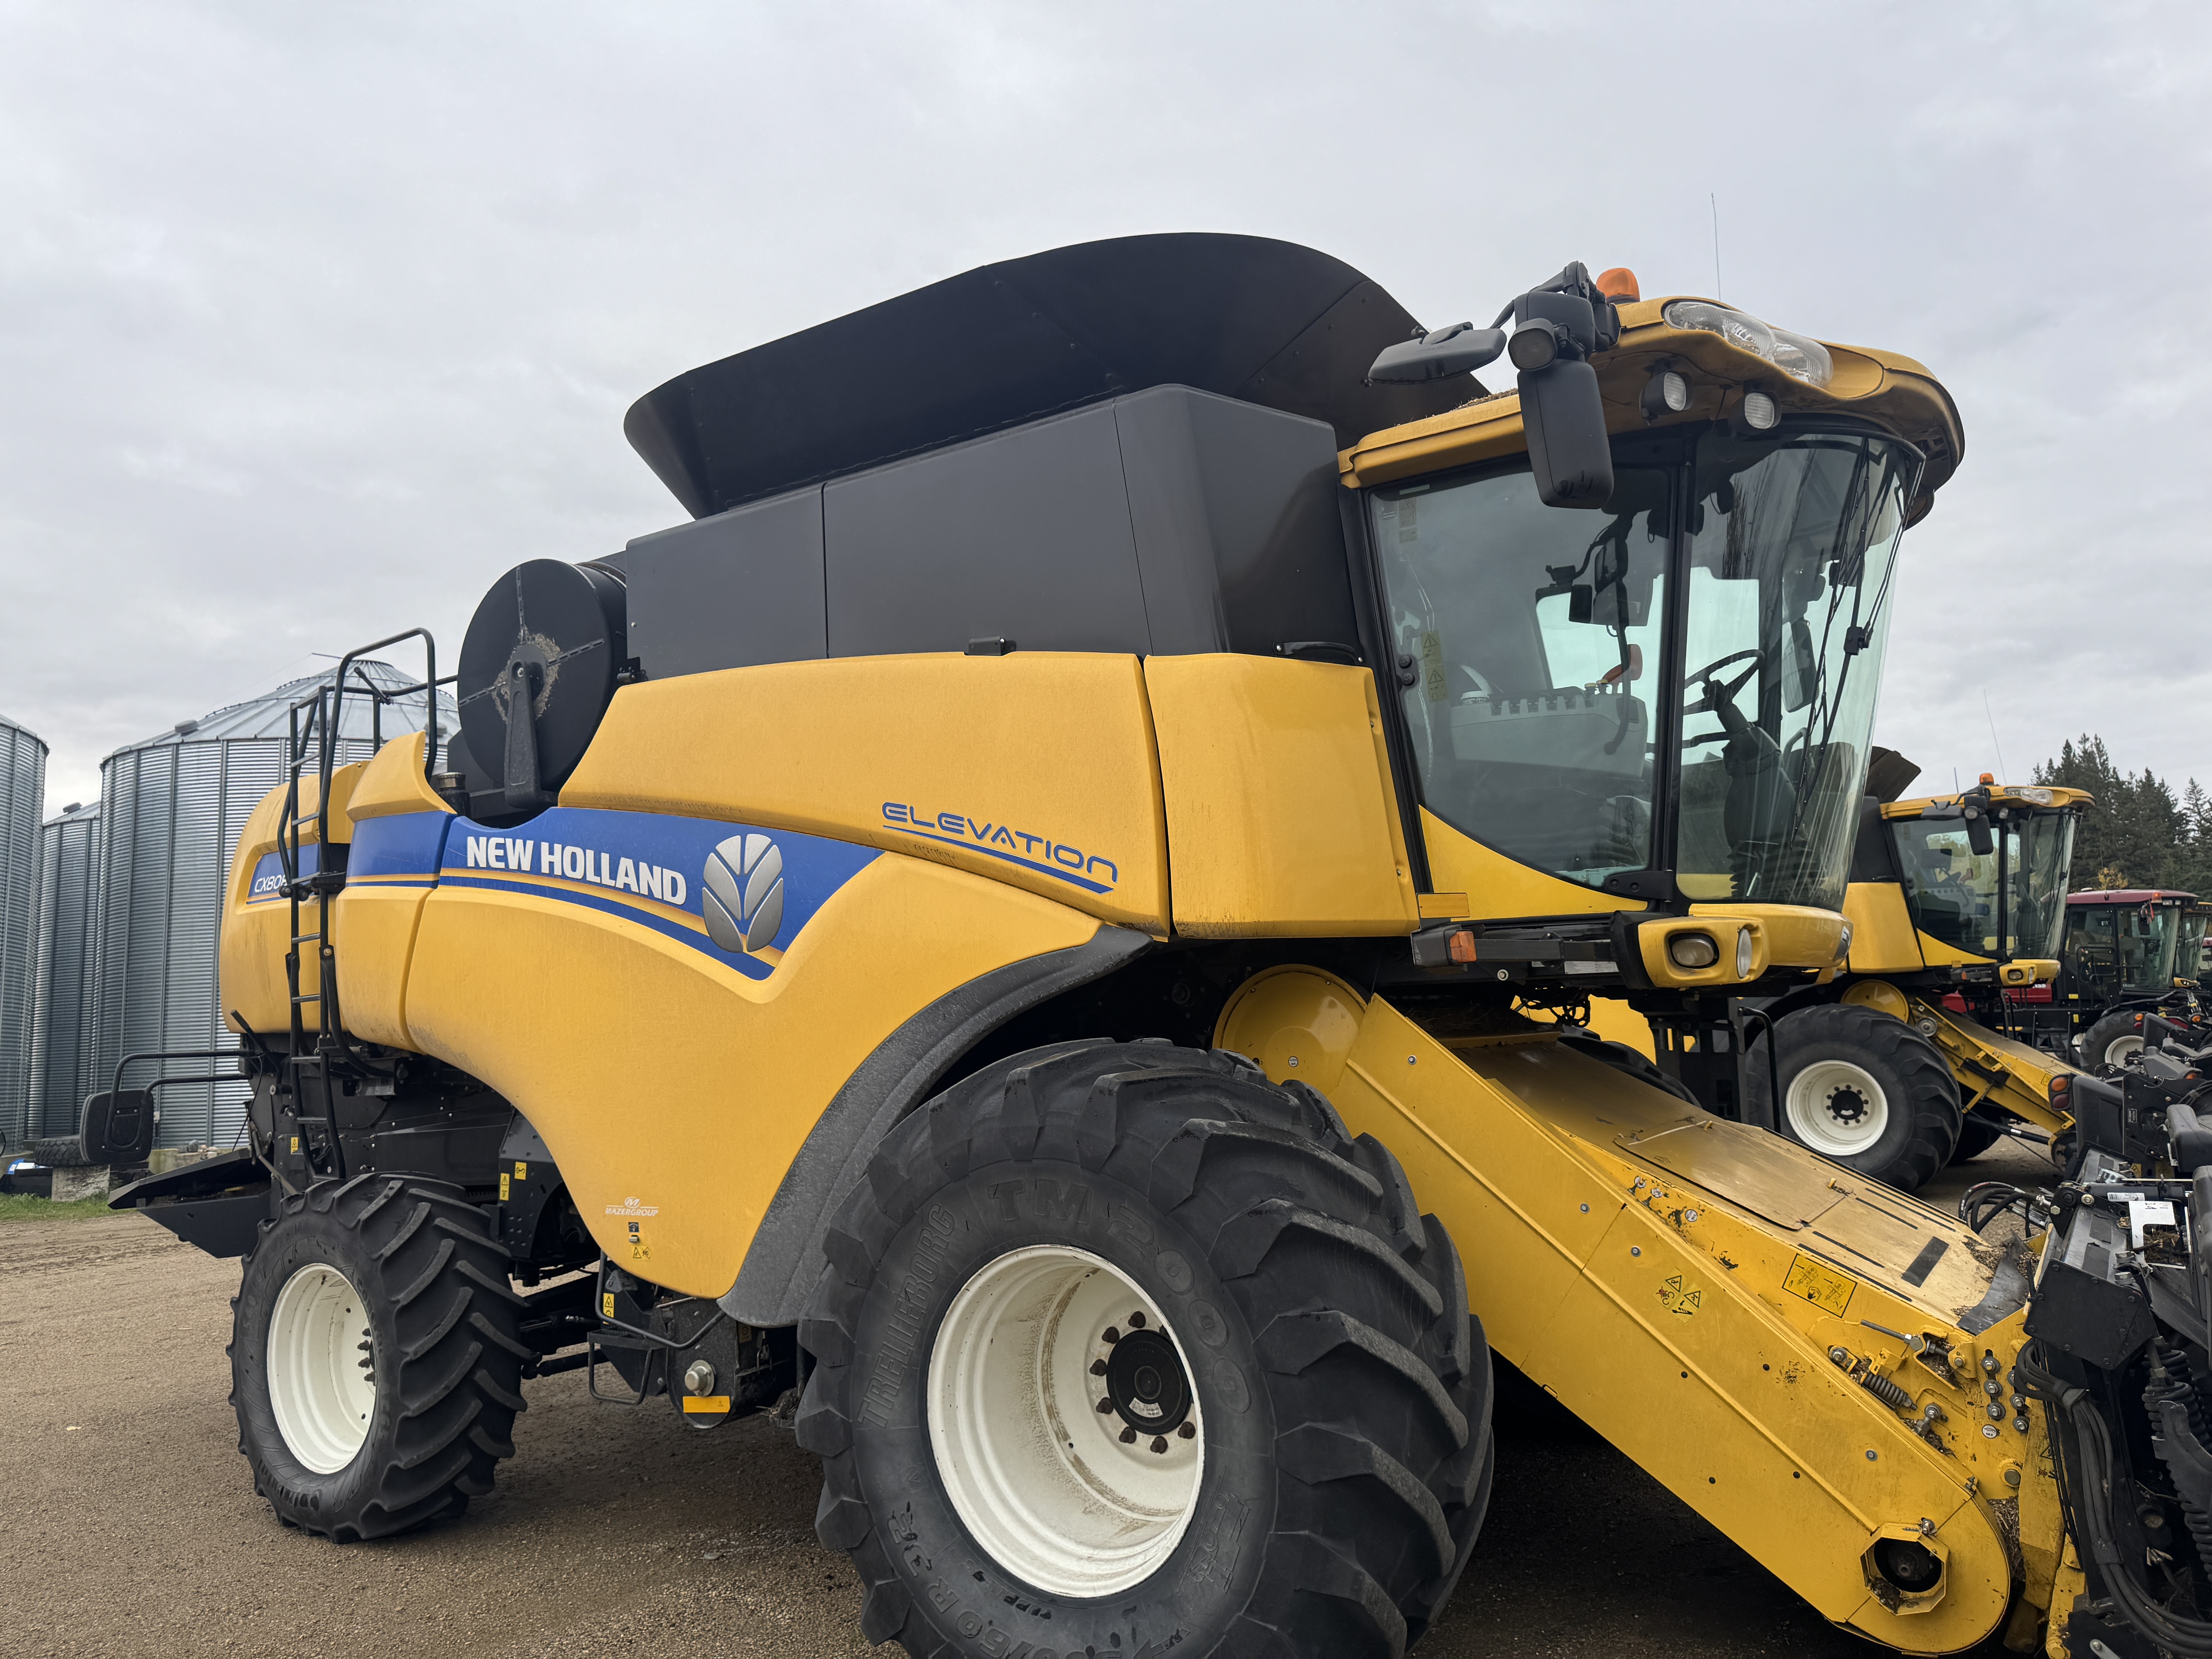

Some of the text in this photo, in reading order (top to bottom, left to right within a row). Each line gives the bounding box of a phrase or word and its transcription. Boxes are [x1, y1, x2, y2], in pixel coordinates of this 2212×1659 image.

[467, 836, 687, 905] NEW HOLLAND
[882, 801, 1118, 883] ELEVATION
[605, 1207, 659, 1216] MAZERGROUP
[856, 1203, 956, 1429] TRELLEBORG
